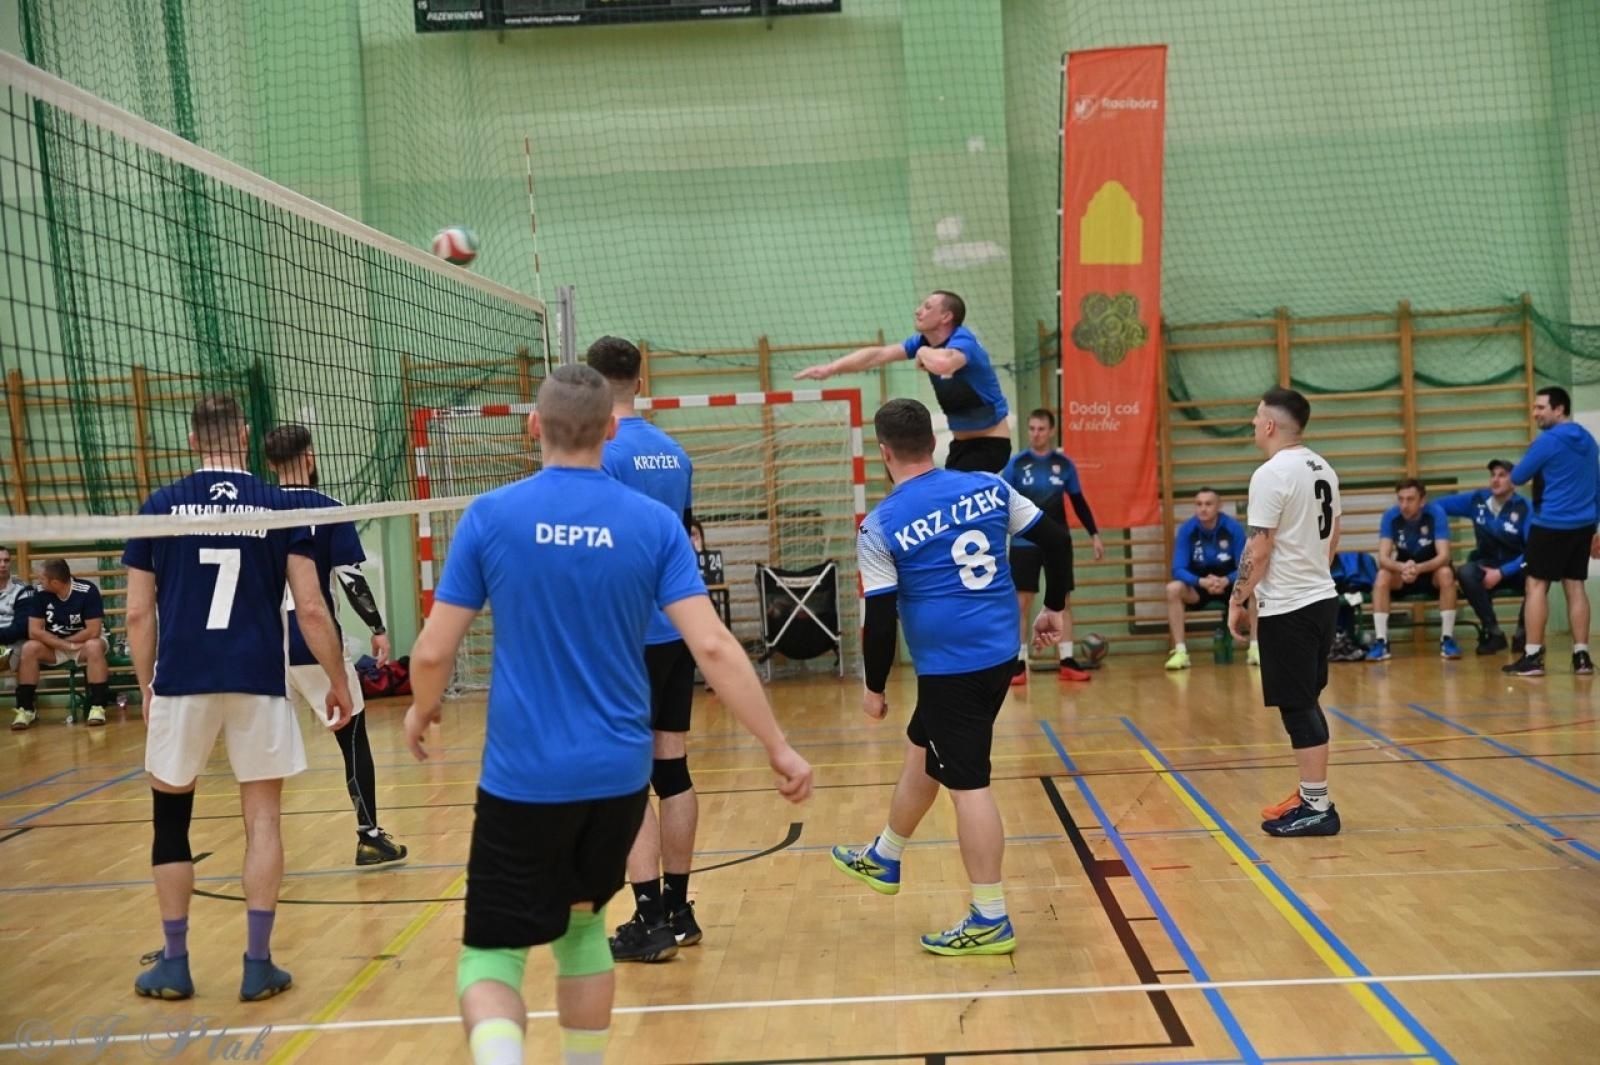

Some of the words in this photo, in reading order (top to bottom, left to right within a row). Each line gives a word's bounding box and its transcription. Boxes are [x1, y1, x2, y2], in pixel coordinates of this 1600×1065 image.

[1069, 400, 1111, 418] Dodaj
[633, 453, 681, 470] KRZYŻEK
[1314, 479, 1332, 540] 3
[535, 523, 614, 548] DEPTA
[708, 554, 722, 570] 24
[951, 529, 997, 590] 8
[199, 548, 241, 629] 7
[45, 610, 55, 623] 2
